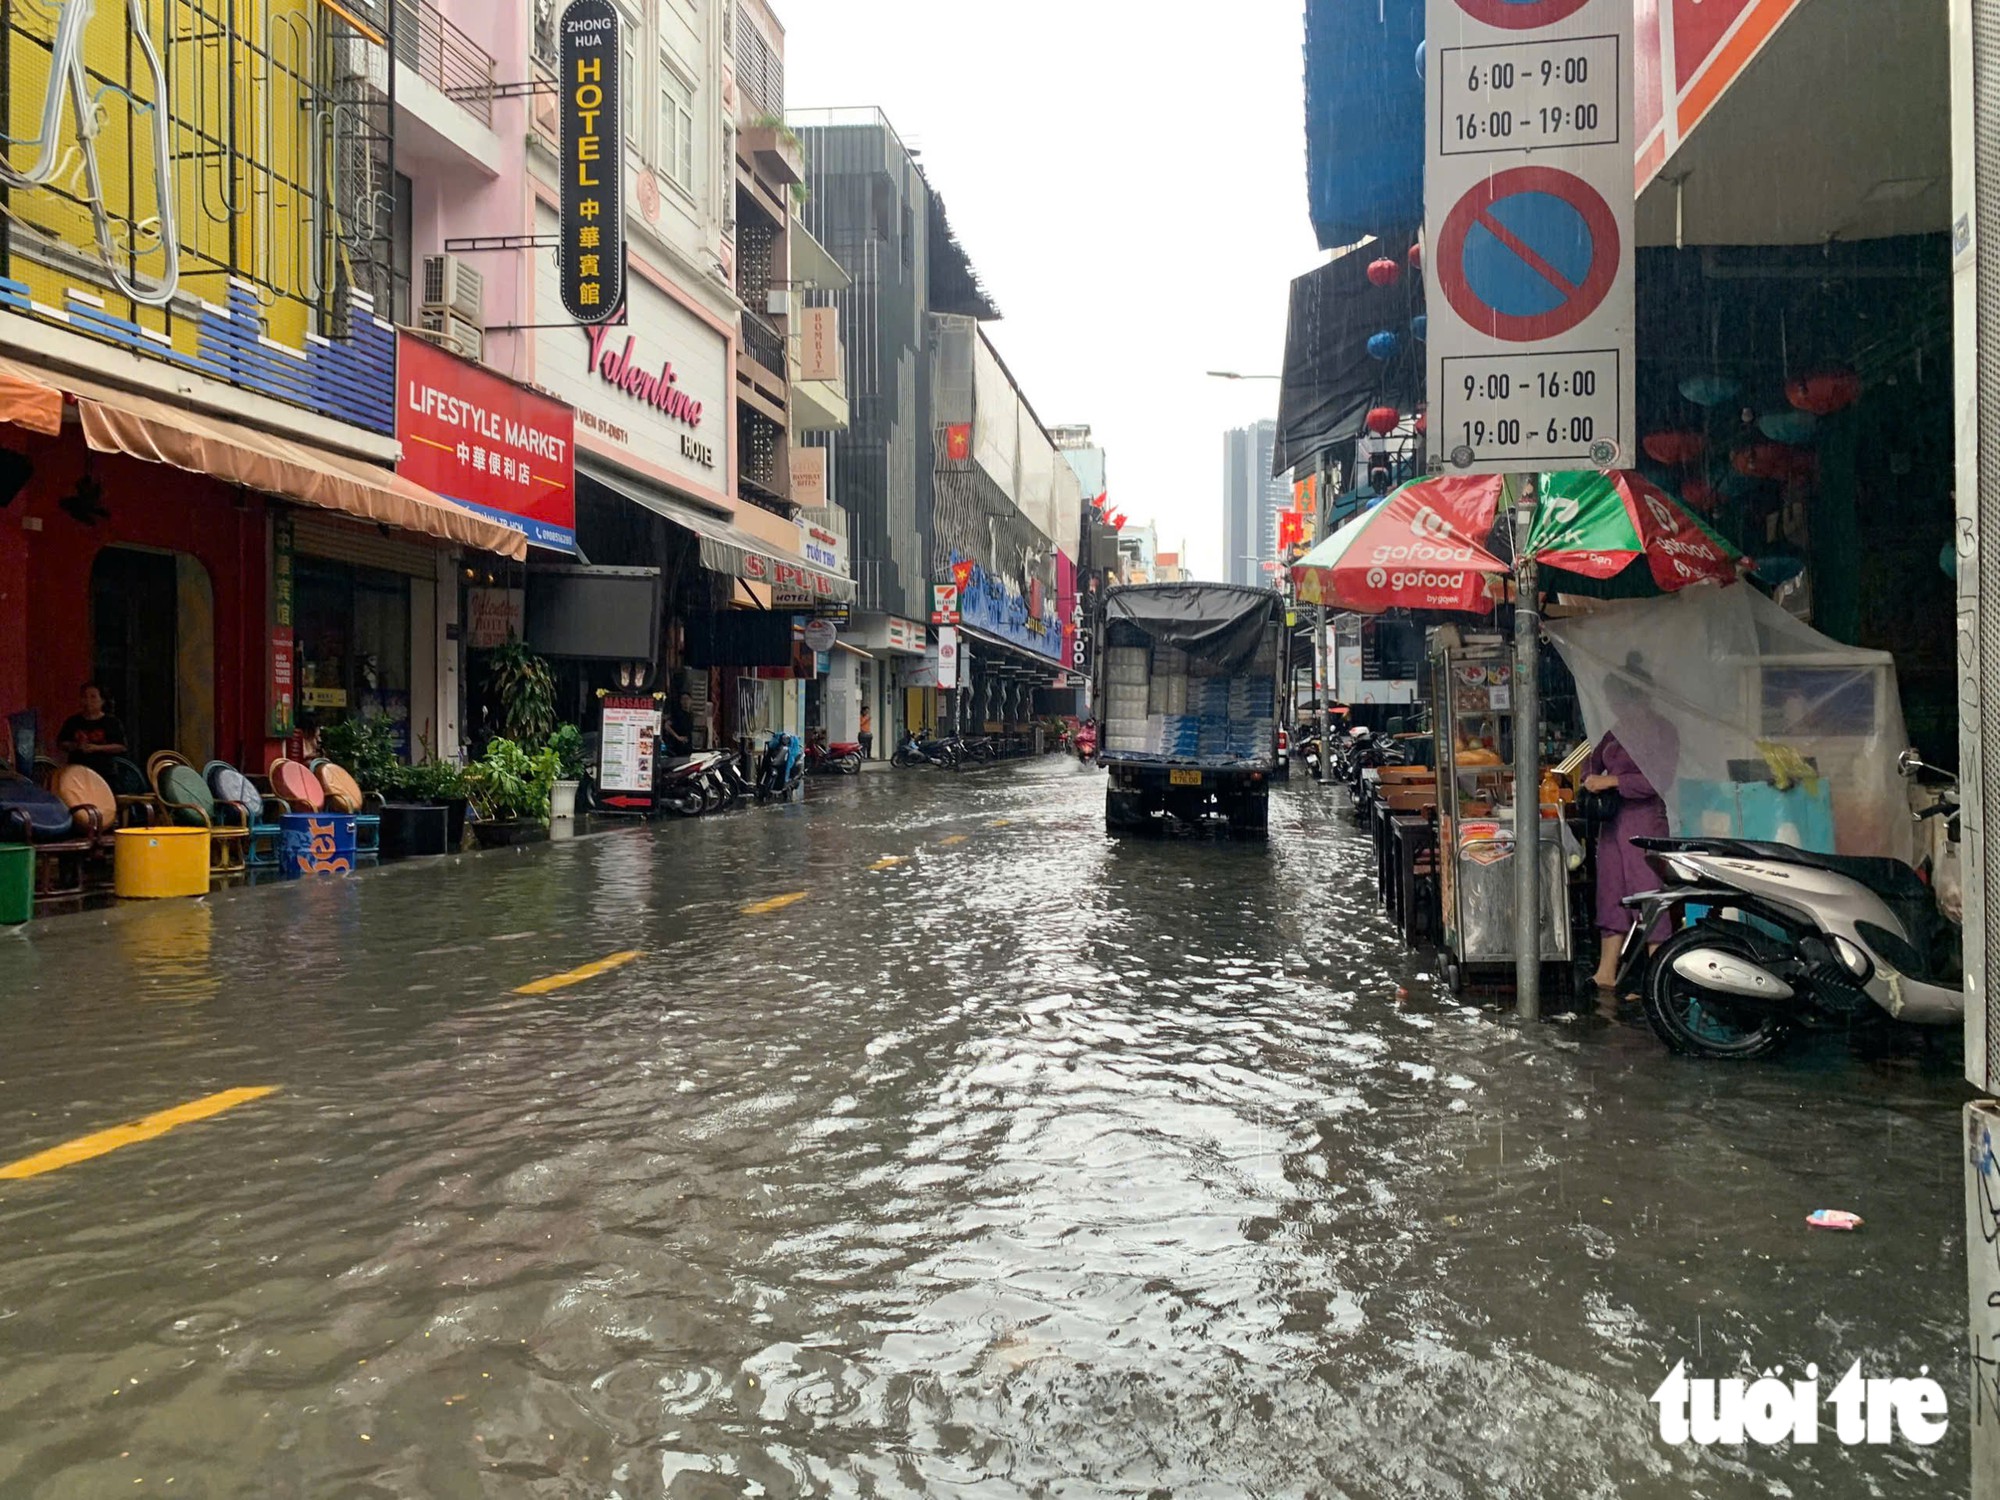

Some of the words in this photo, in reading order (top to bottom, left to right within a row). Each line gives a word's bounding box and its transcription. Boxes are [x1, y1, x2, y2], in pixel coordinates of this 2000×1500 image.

[566, 17, 611, 33] ZHONG
[575, 36, 602, 48] HUA
[1468, 63, 1514, 91] 6:00
[1540, 57, 1588, 86] 9:00
[576, 58, 602, 187] HOTEL
[1456, 110, 1512, 140] 16:00
[1539, 103, 1598, 134] 19:00
[579, 197, 600, 306] 中華賓館
[1464, 374, 1510, 401] 9:00
[1537, 370, 1595, 398] 16:00
[409, 380, 501, 441] LIFESTYLE
[505, 418, 566, 464] MARKET
[1463, 418, 1520, 446] 19:00
[1546, 416, 1594, 444] 6:00
[456, 441, 530, 486] 中華便利店
[682, 435, 715, 467] HOTEL
[1370, 542, 1474, 565] gofood
[1391, 571, 1465, 591] gofood
[776, 593, 810, 602] HOTEL
[1426, 594, 1437, 604] by
[1073, 592, 1085, 664] TATTOO
[605, 696, 654, 709] MASSAGE
